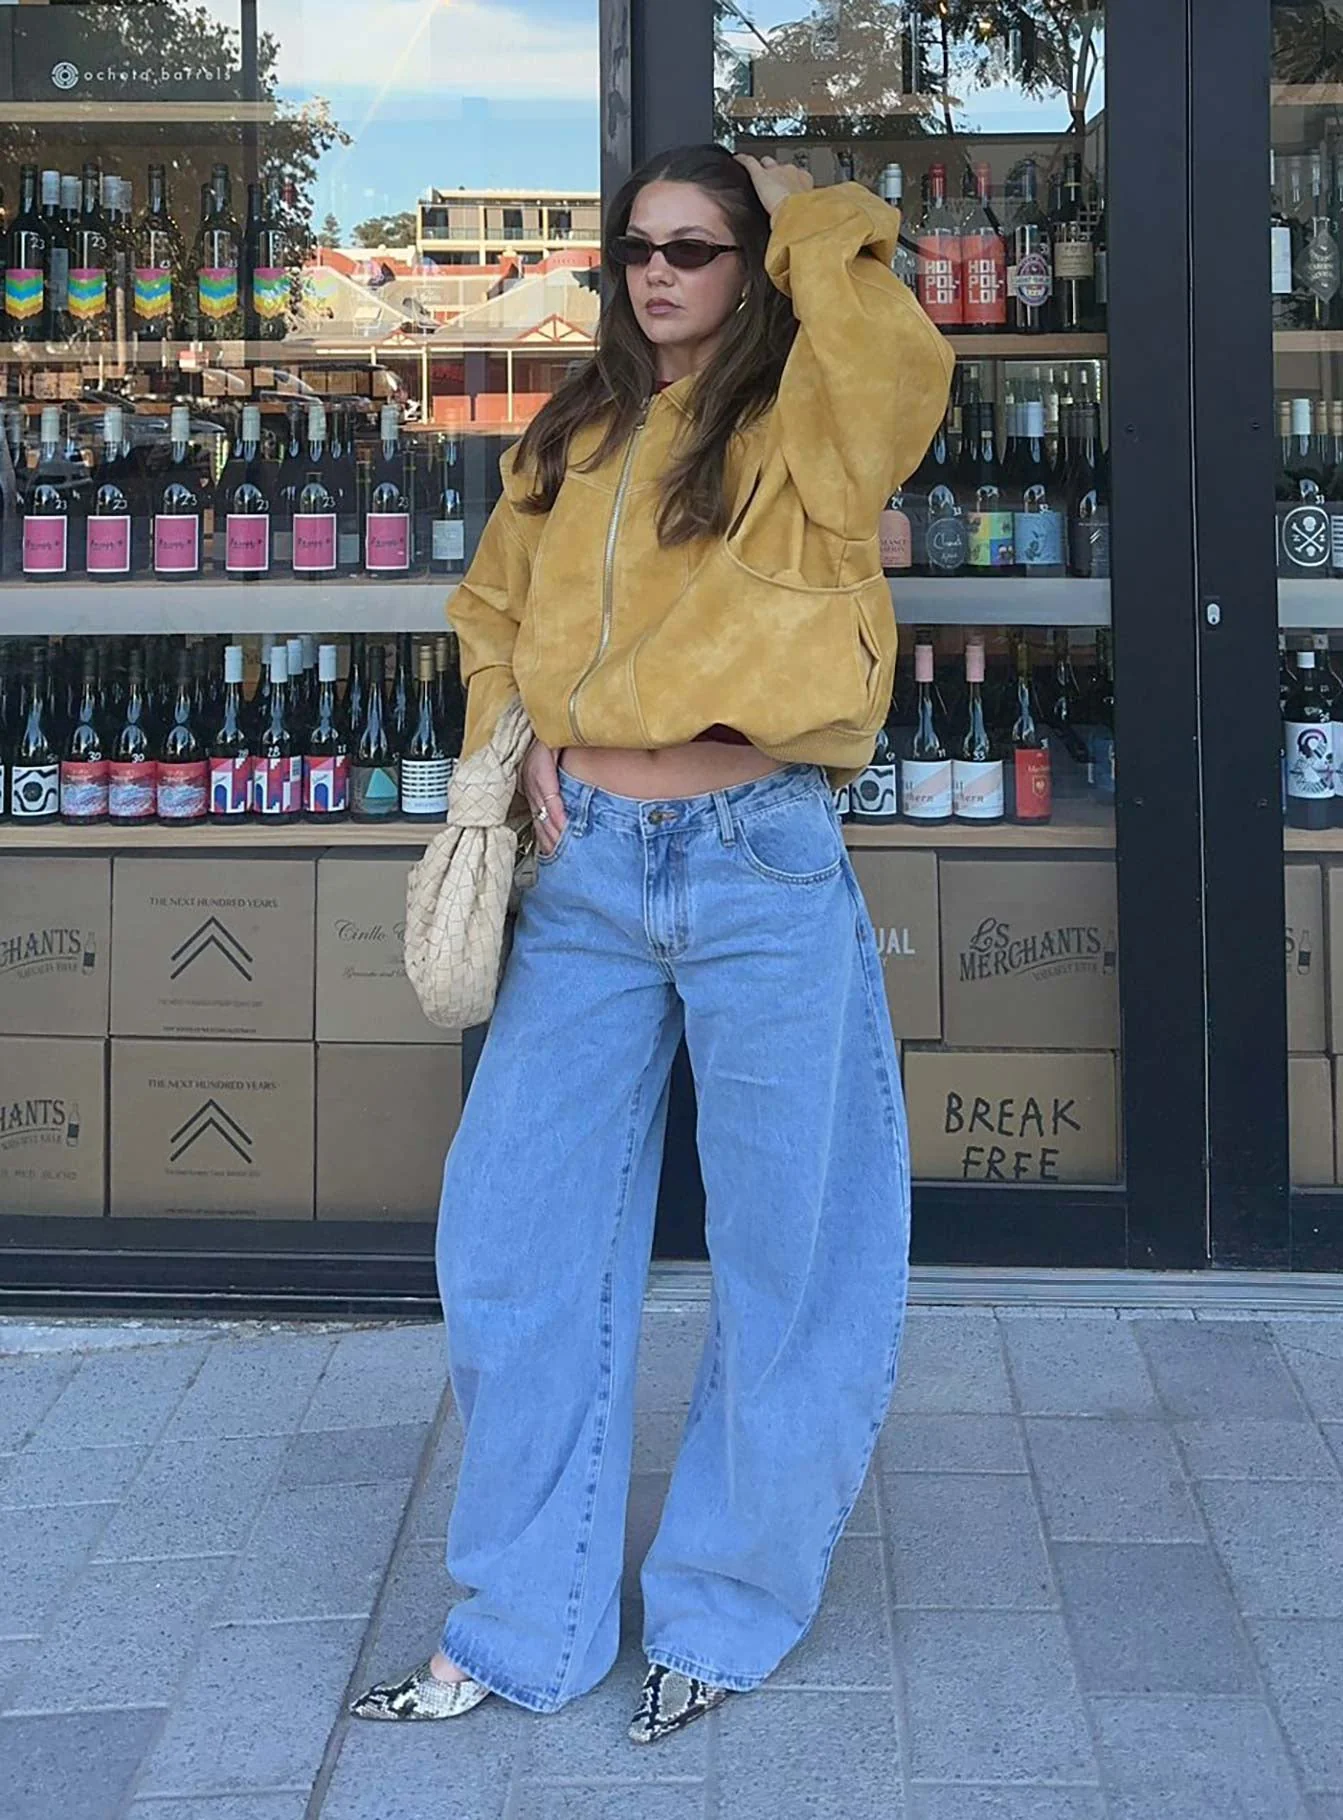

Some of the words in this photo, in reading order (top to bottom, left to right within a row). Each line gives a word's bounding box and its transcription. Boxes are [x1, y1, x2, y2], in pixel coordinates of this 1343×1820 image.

[161, 67, 231, 81] barrels
[31, 236, 45, 250] 23
[91, 236, 107, 250] 23
[925, 260, 952, 274] HOI
[969, 260, 995, 274] HOI
[925, 290, 953, 304] LOI
[969, 290, 996, 304] LOI
[55, 499, 67, 510] 23
[180, 492, 197, 506] 23
[323, 496, 336, 508] 23
[88, 750, 102, 762] 30
[131, 752, 145, 763] 30
[150, 896, 167, 907] THE
[169, 897, 195, 907] NEXT
[196, 898, 246, 908] HUNDRED
[247, 899, 278, 909] YEARS
[960, 927, 1101, 981] MERCHANTS
[148, 1078, 166, 1088] THE
[168, 1079, 194, 1089] NEXT
[195, 1080, 244, 1090] HUNDRED
[246, 1081, 278, 1091] YEARS
[945, 1091, 1081, 1138] BREAK
